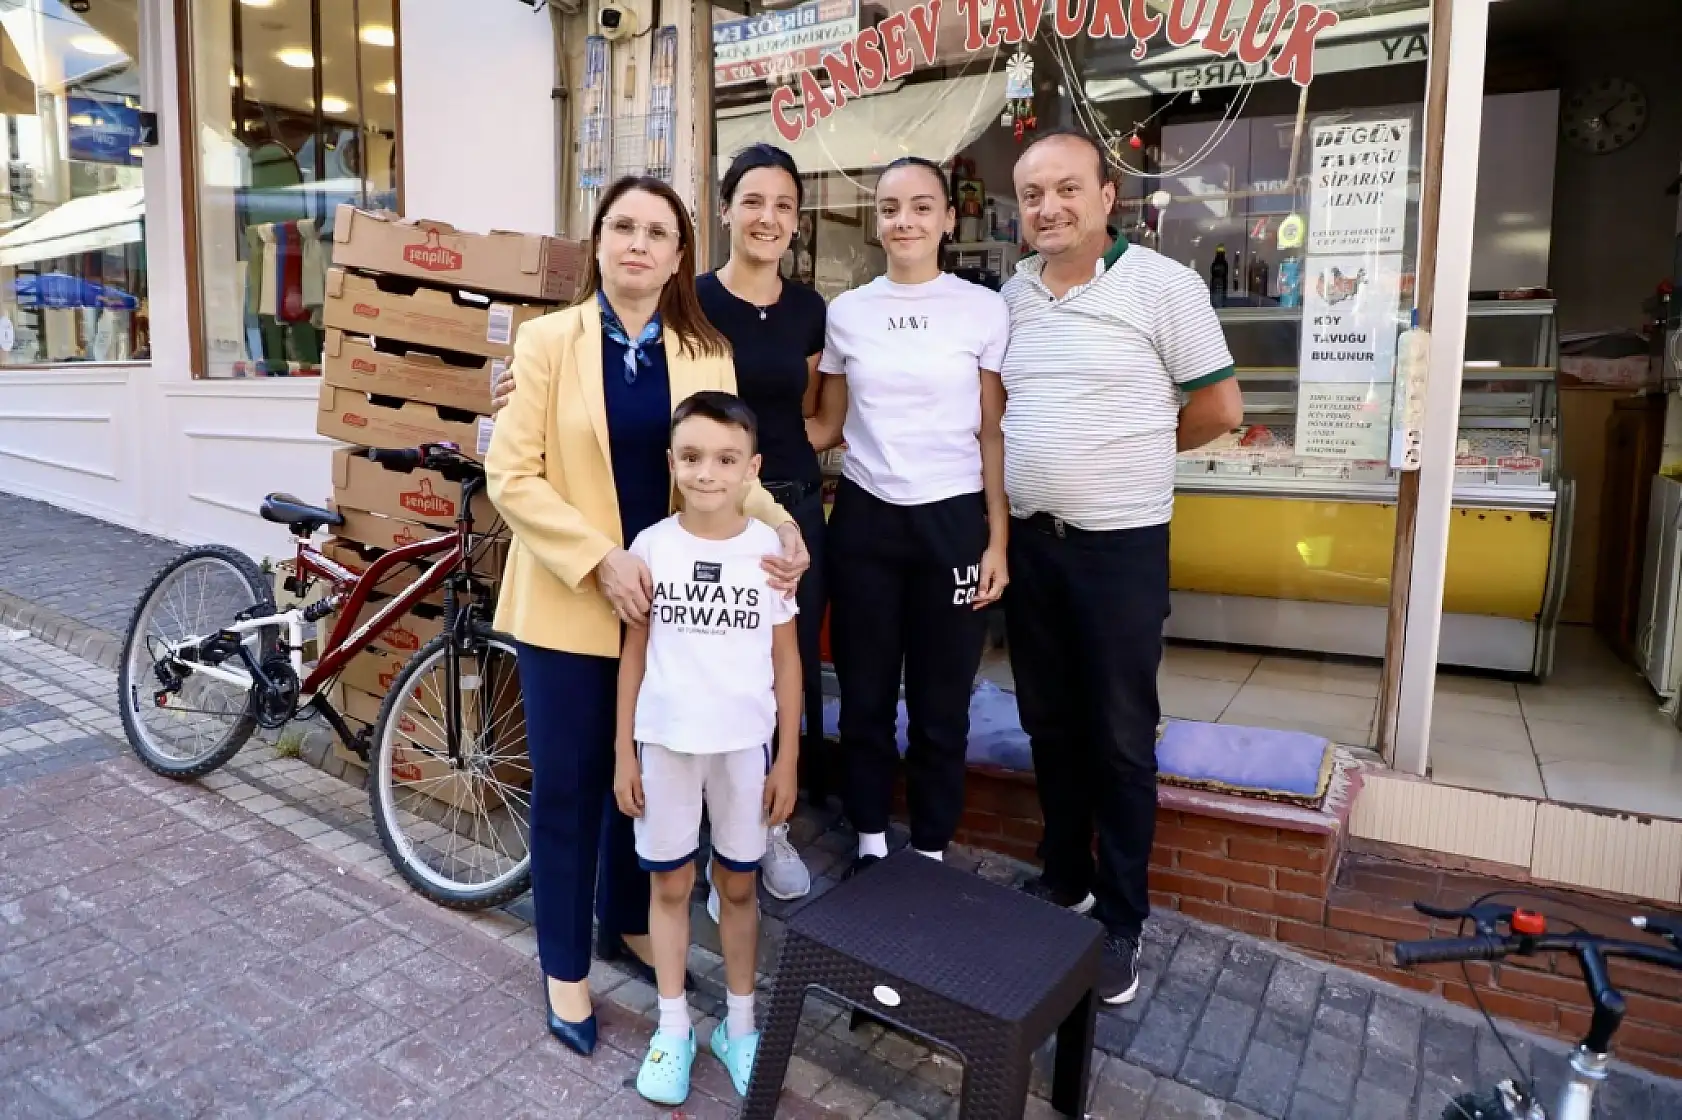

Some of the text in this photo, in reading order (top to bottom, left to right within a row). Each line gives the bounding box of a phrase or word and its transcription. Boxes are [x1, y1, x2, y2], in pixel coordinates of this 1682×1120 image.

[771, 0, 942, 142] CANSEV
[1311, 350, 1375, 362] BULUNUR
[654, 581, 760, 607] ALWAYS
[653, 604, 761, 630] FORWARD
